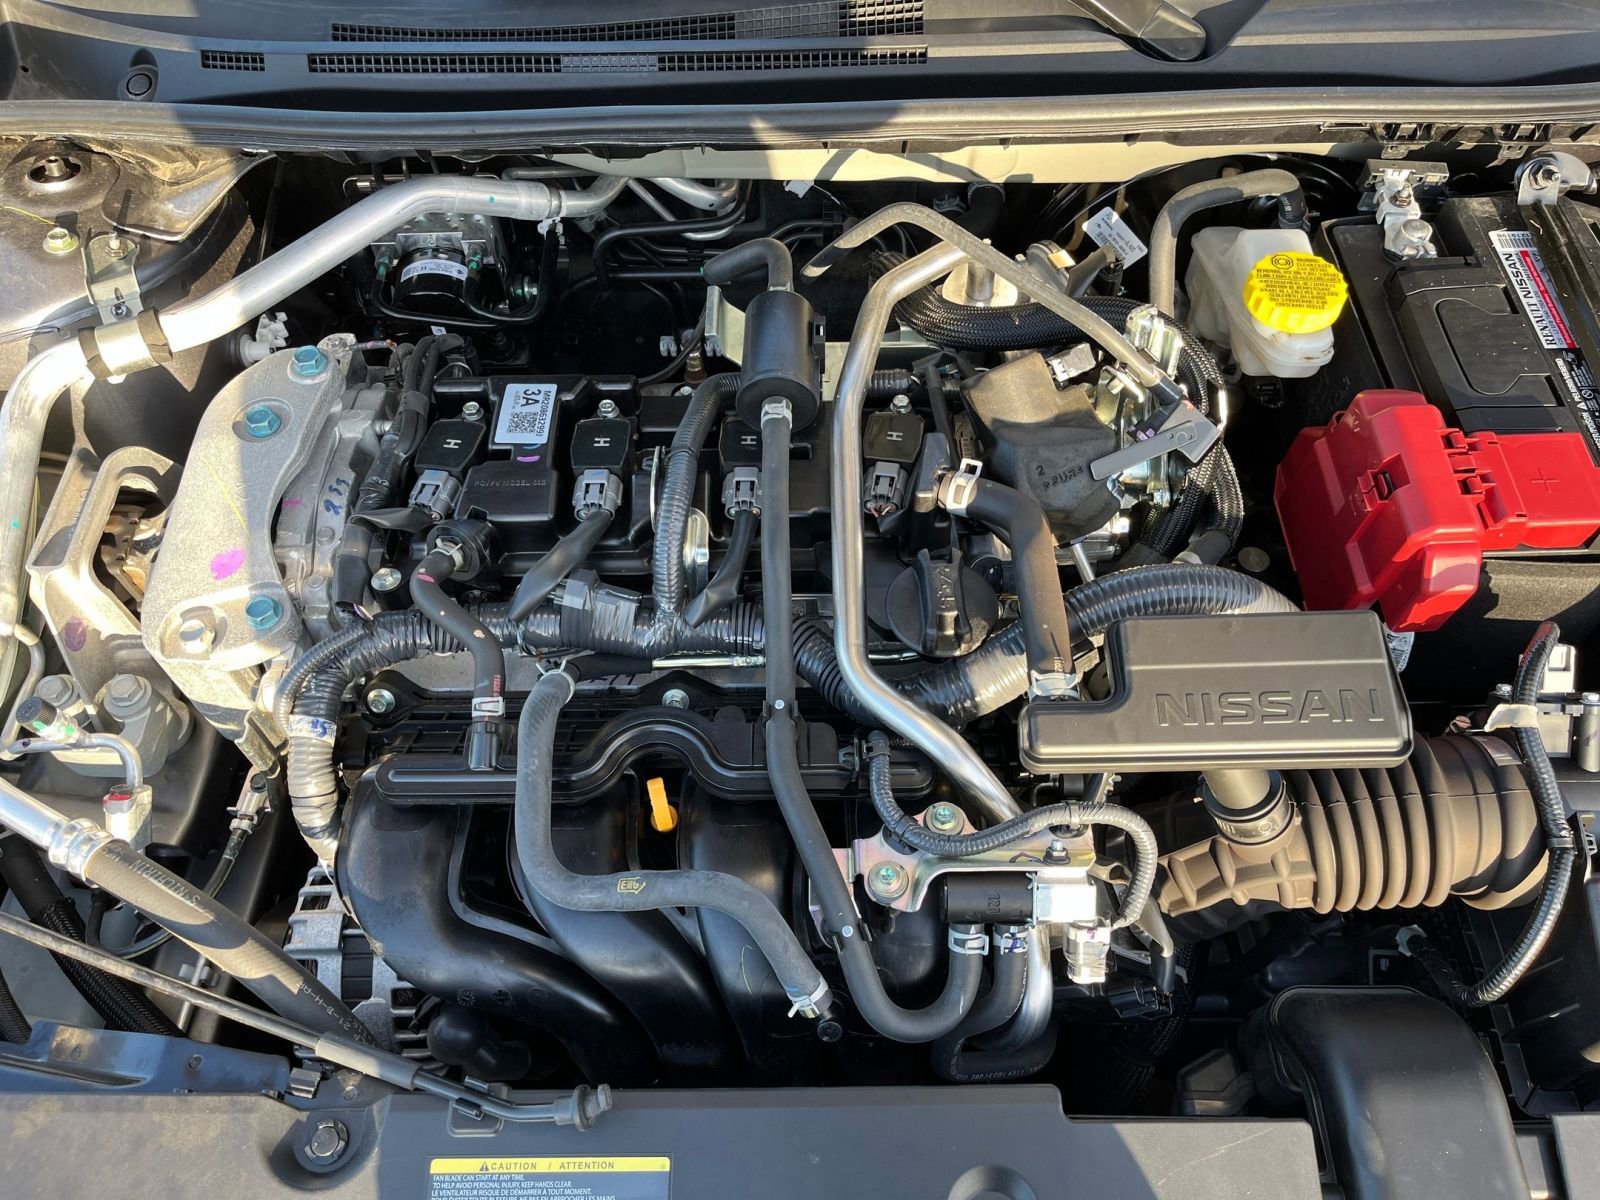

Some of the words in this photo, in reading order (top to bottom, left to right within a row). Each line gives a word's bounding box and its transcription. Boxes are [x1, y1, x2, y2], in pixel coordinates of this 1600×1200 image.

[1503, 253, 1534, 299] NISSAN
[1528, 303, 1557, 346] RENAULT
[520, 389, 541, 407] 3A
[1155, 688, 1385, 727] NISSAN
[491, 1162, 537, 1171] CAUTION
[559, 1161, 615, 1170] ATTENTION
[478, 1189, 500, 1197] RISQUE
[509, 1188, 542, 1196] DÉMARRER
[542, 1188, 547, 1196] À
